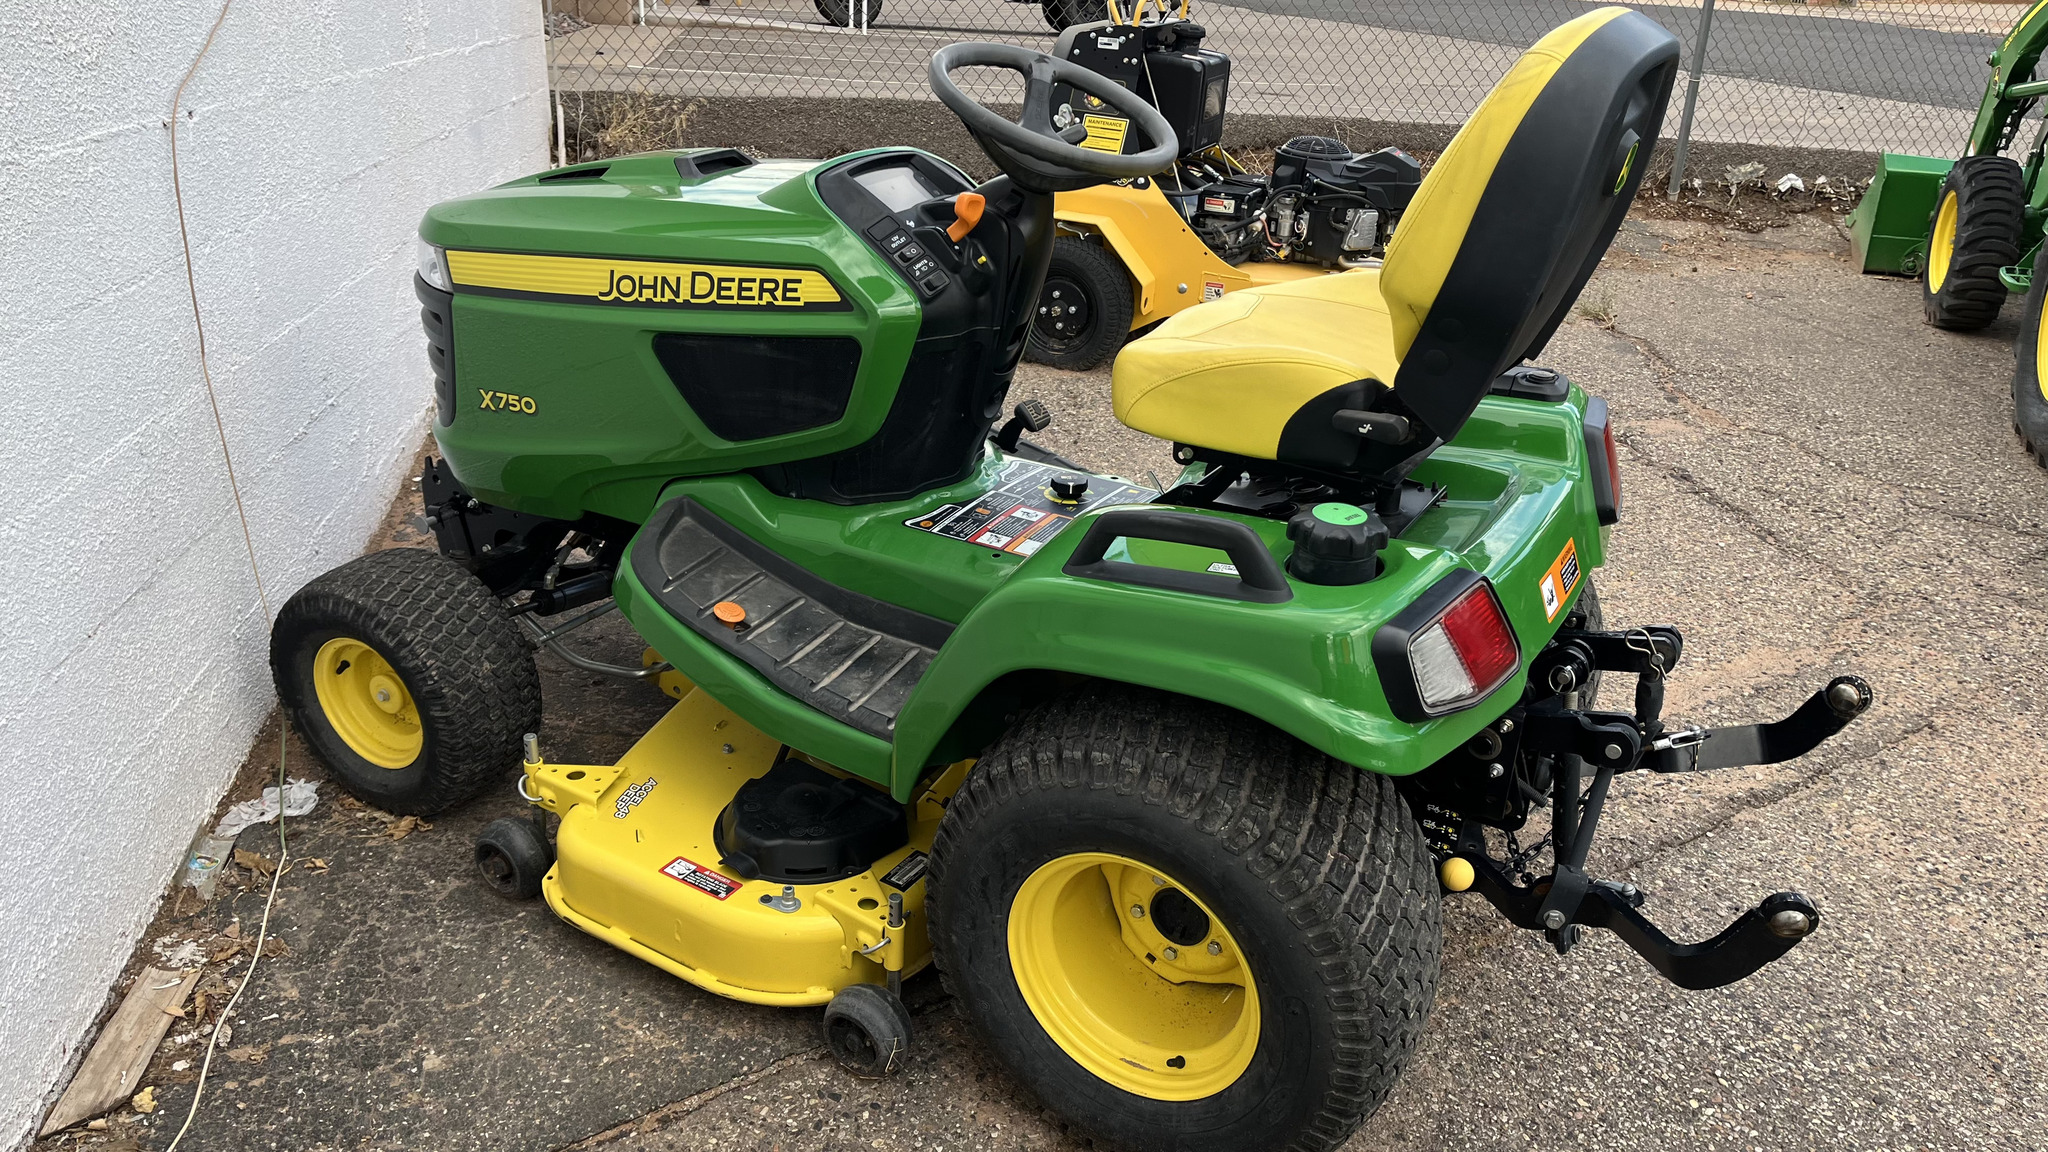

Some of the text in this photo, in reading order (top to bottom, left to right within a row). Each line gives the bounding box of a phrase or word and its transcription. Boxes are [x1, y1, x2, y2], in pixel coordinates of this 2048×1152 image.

[1087, 118, 1123, 128] MAINTENANCE
[912, 259, 928, 270] LIGHTS
[598, 269, 804, 304] JOHN DEERE
[478, 388, 537, 414] X750
[614, 777, 658, 819] ACCEL 48
[615, 783, 642, 810] DEEP
[709, 871, 731, 884] DANGER
